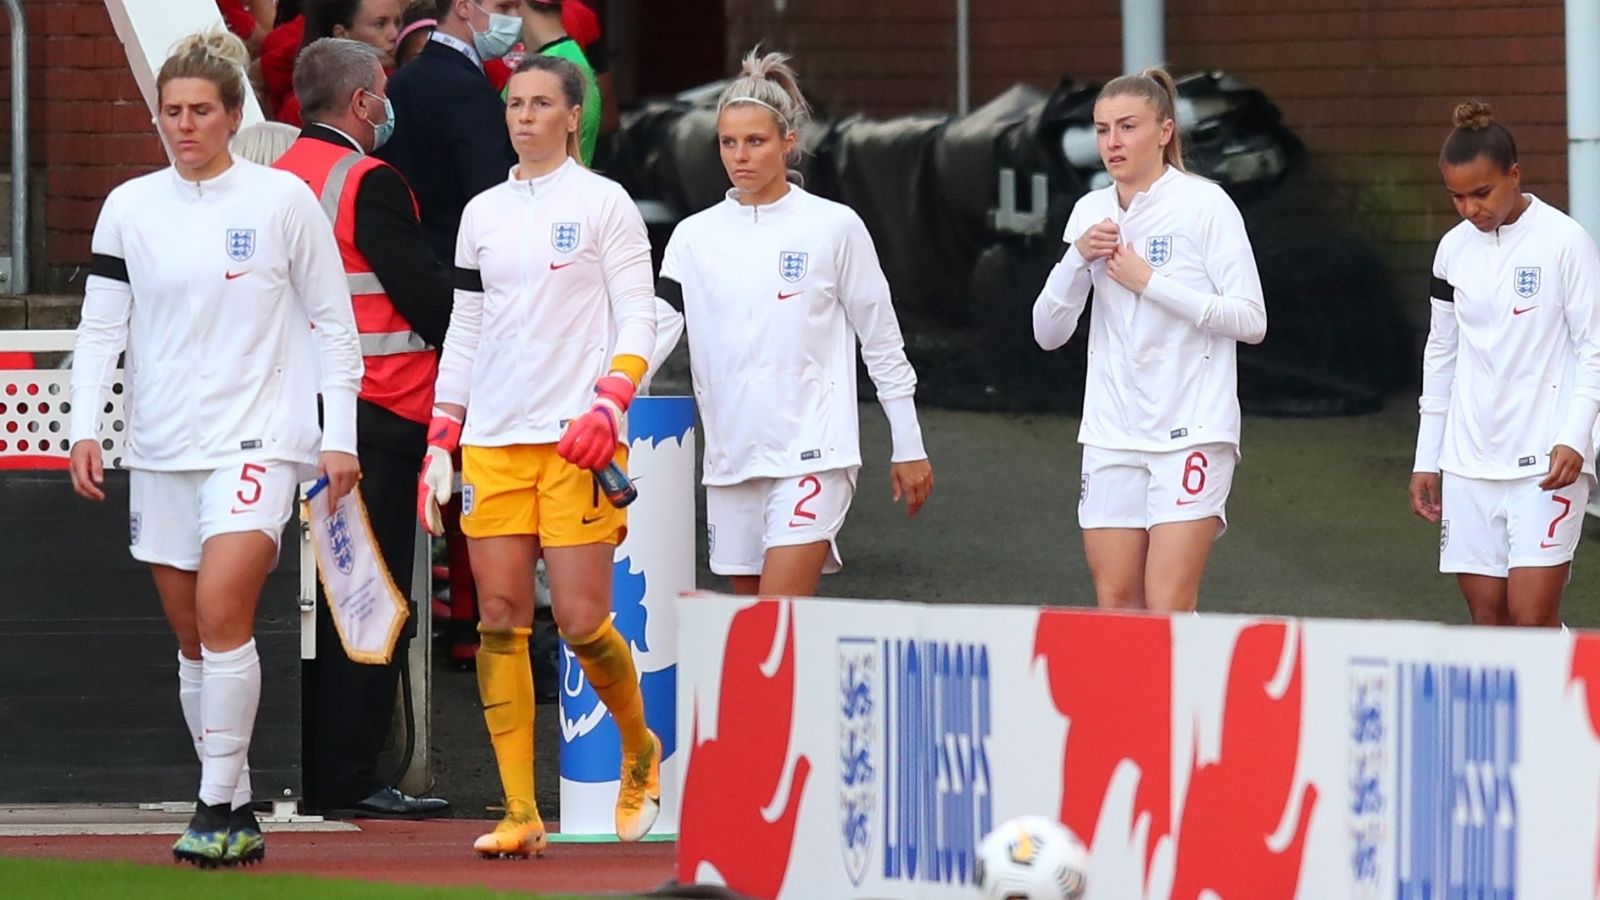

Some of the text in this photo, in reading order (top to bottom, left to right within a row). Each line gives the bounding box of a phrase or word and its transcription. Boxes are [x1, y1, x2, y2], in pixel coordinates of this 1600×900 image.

[236, 463, 266, 505] 5
[1182, 450, 1208, 496] 6
[794, 474, 821, 520] 2
[1547, 494, 1572, 539] 7
